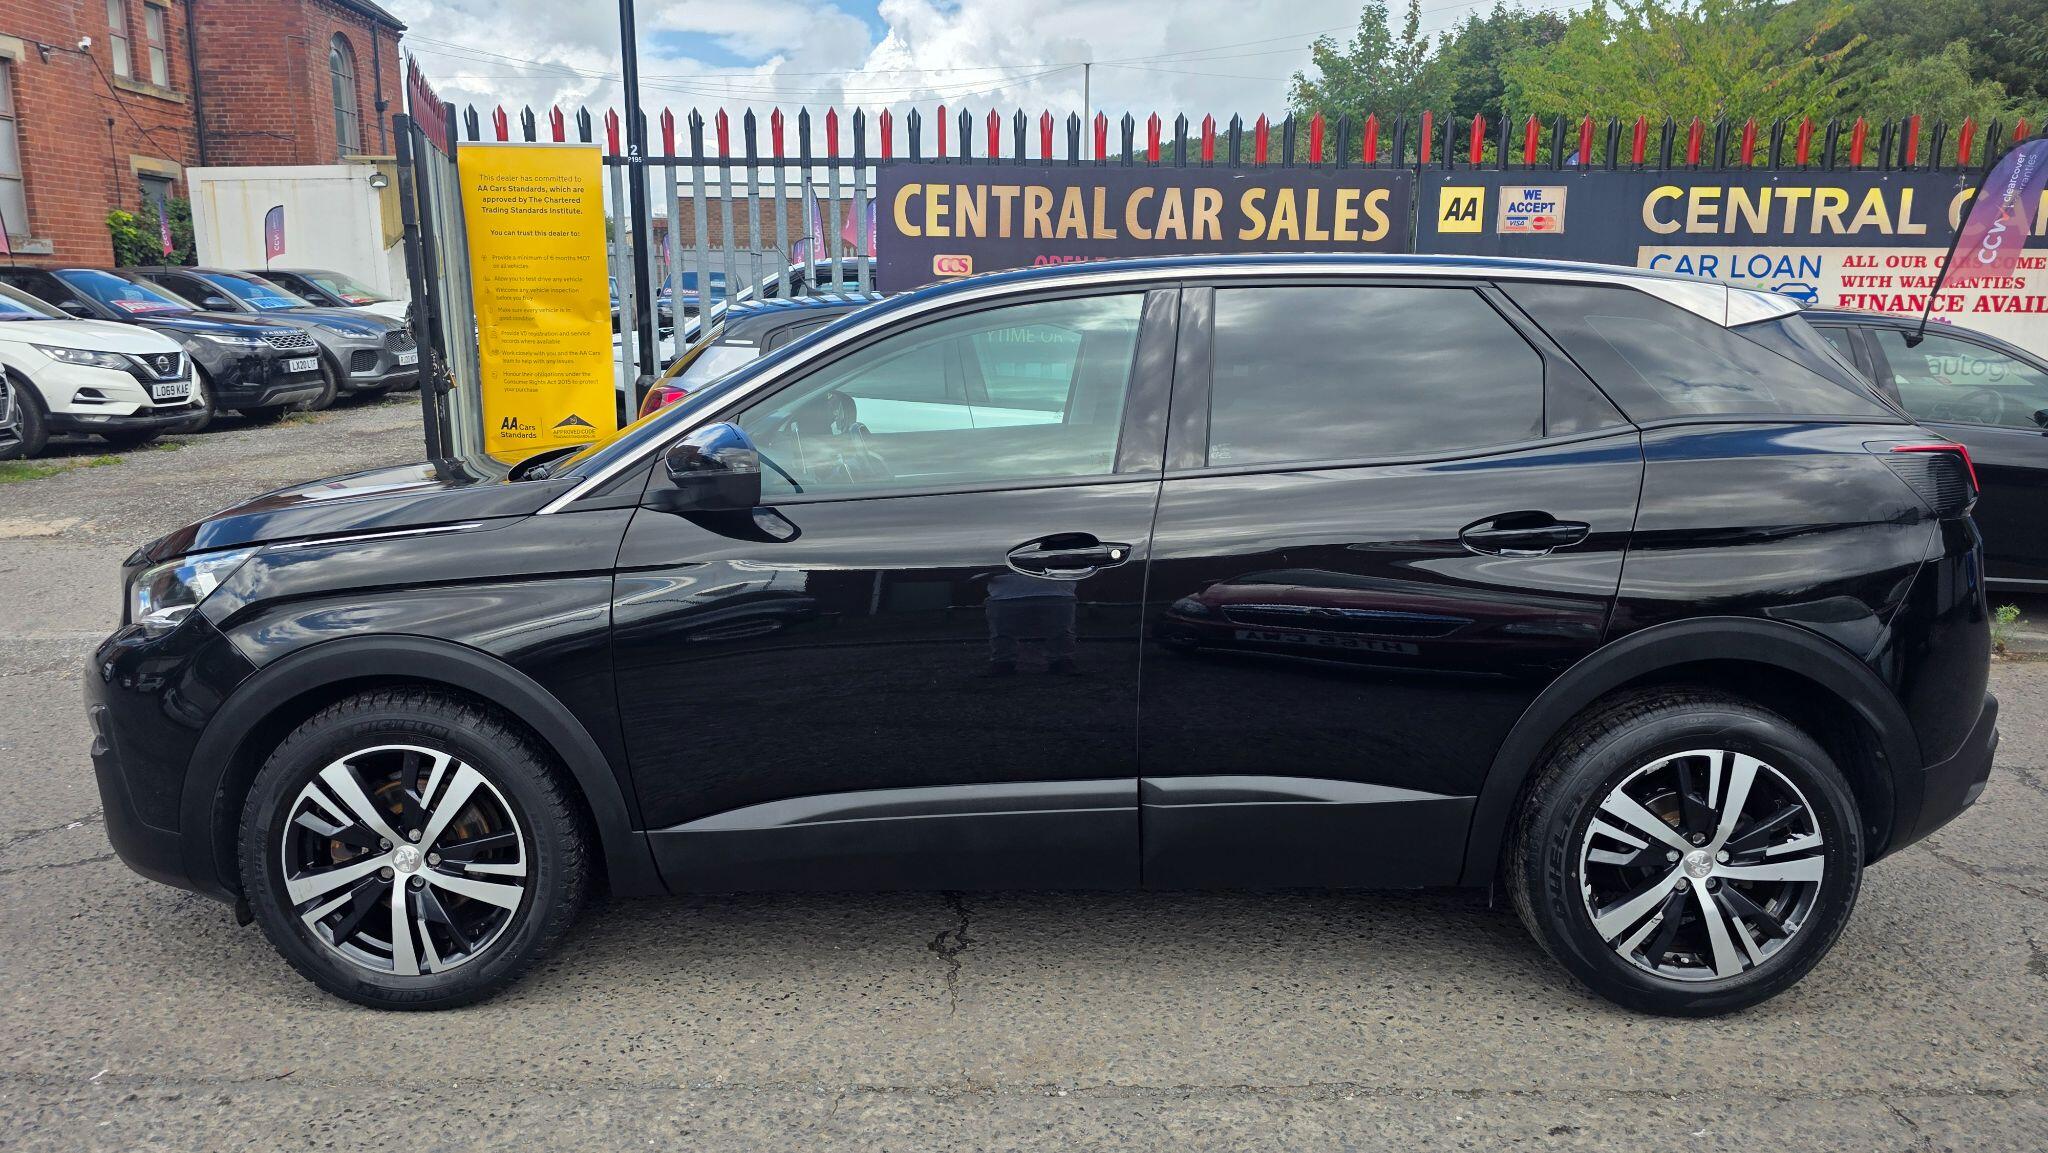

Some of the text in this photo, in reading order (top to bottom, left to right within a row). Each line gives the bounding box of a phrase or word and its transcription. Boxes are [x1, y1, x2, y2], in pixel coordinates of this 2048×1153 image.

[630, 145, 638, 155] 2
[496, 174, 518, 182] dealer
[2003, 153, 2026, 202] clearcover
[508, 185, 547, 193] Standards,
[1523, 189, 1542, 200] WE
[482, 196, 516, 204] approved
[481, 206, 509, 215] Trading
[894, 183, 1390, 242] CENTRAL CAR SALES
[1443, 197, 1478, 221] AA
[1508, 202, 1555, 213] ACCEPT
[1642, 185, 1926, 235] CENTRAL
[1978, 204, 2010, 264] CCW
[937, 257, 969, 273] CCS
[1650, 254, 1822, 278] CAR LOAN
[1842, 256, 1879, 268] ALL
[1885, 255, 1928, 268] OUR
[1841, 276, 1893, 288] WITH
[1838, 294, 2048, 313] FINANCE AVAIL
[156, 384, 189, 397] LO69 KAE
[501, 417, 536, 431] AA Cars
[500, 431, 537, 439] Standards
